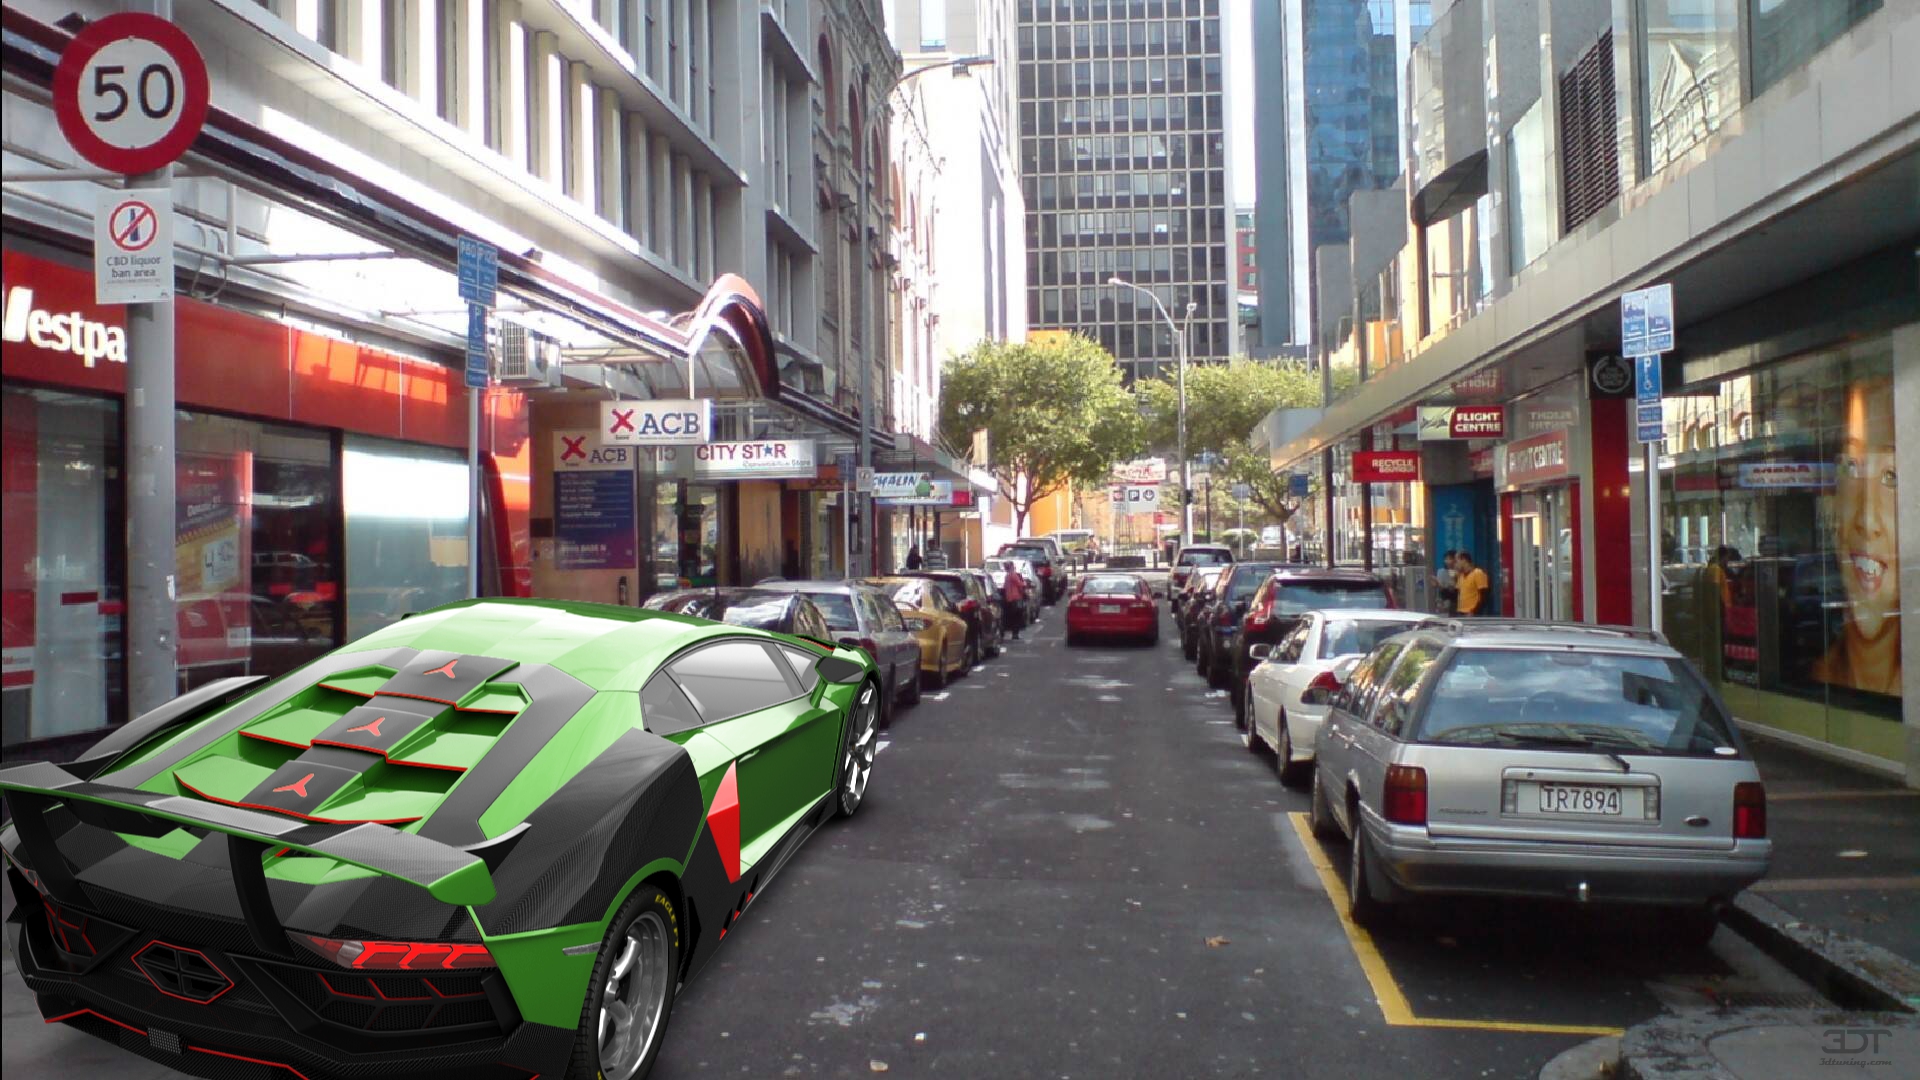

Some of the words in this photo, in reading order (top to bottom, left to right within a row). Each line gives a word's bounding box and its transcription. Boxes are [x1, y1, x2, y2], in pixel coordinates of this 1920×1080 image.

[95, 64, 175, 121] 50
[106, 256, 129, 266] CBD
[131, 254, 161, 267] liquor
[112, 268, 131, 278] ban
[134, 269, 156, 277] area
[3, 286, 127, 368] estpa
[638, 412, 700, 435] ACB
[1456, 412, 1500, 422] FLIGHT
[1455, 423, 1501, 433] CENTRE
[588, 447, 628, 463] ACB
[696, 443, 737, 461] CITY
[1371, 458, 1414, 467] RECYCLE
[1543, 787, 1618, 812] TR7894
[654, 894, 676, 924] EAGLE
